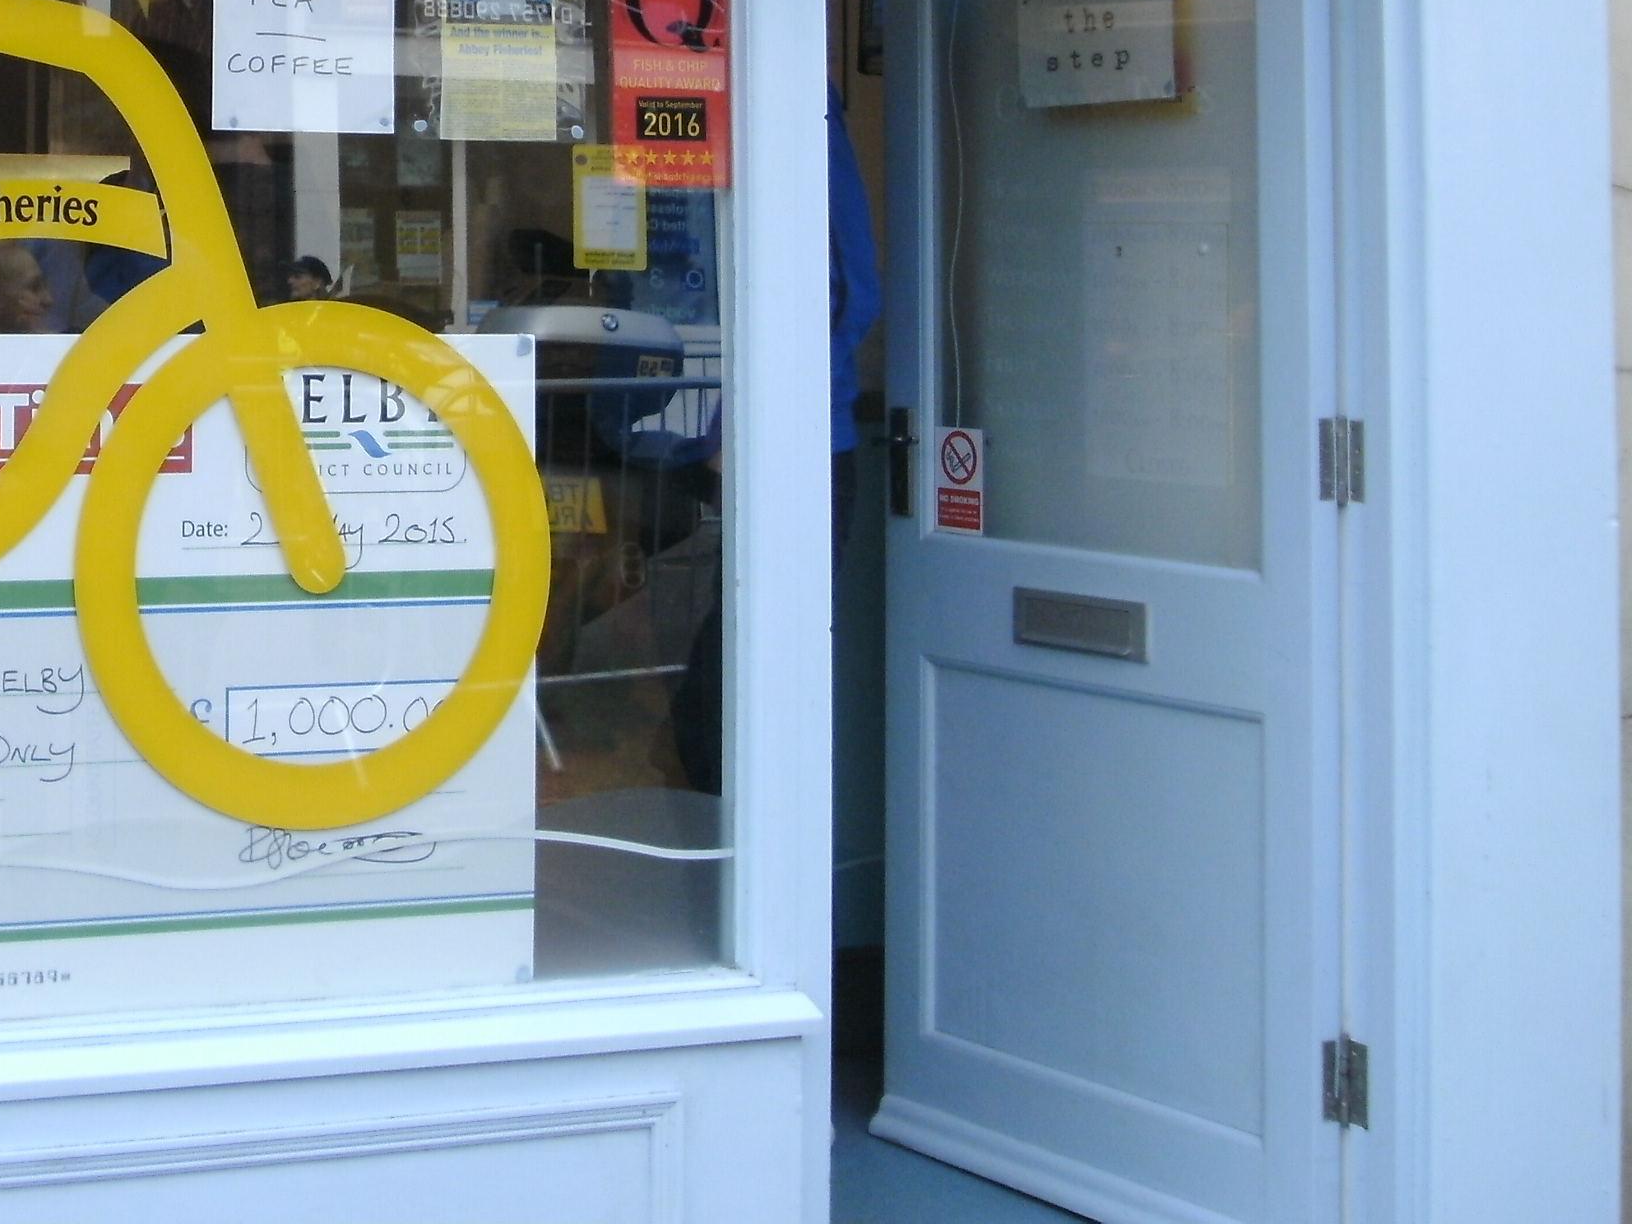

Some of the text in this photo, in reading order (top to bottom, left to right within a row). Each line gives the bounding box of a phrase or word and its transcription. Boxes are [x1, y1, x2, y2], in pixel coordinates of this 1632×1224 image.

[1063, 7, 1115, 34] the
[227, 52, 354, 76] COFFEE
[632, 58, 662, 72] FISH
[677, 59, 708, 73] CHIP
[1045, 49, 1131, 72] step
[618, 75, 721, 91] QUALITY AWARD
[643, 111, 701, 137] 2016
[362, 462, 454, 477] COUNCIL
[181, 519, 229, 539] Date:
